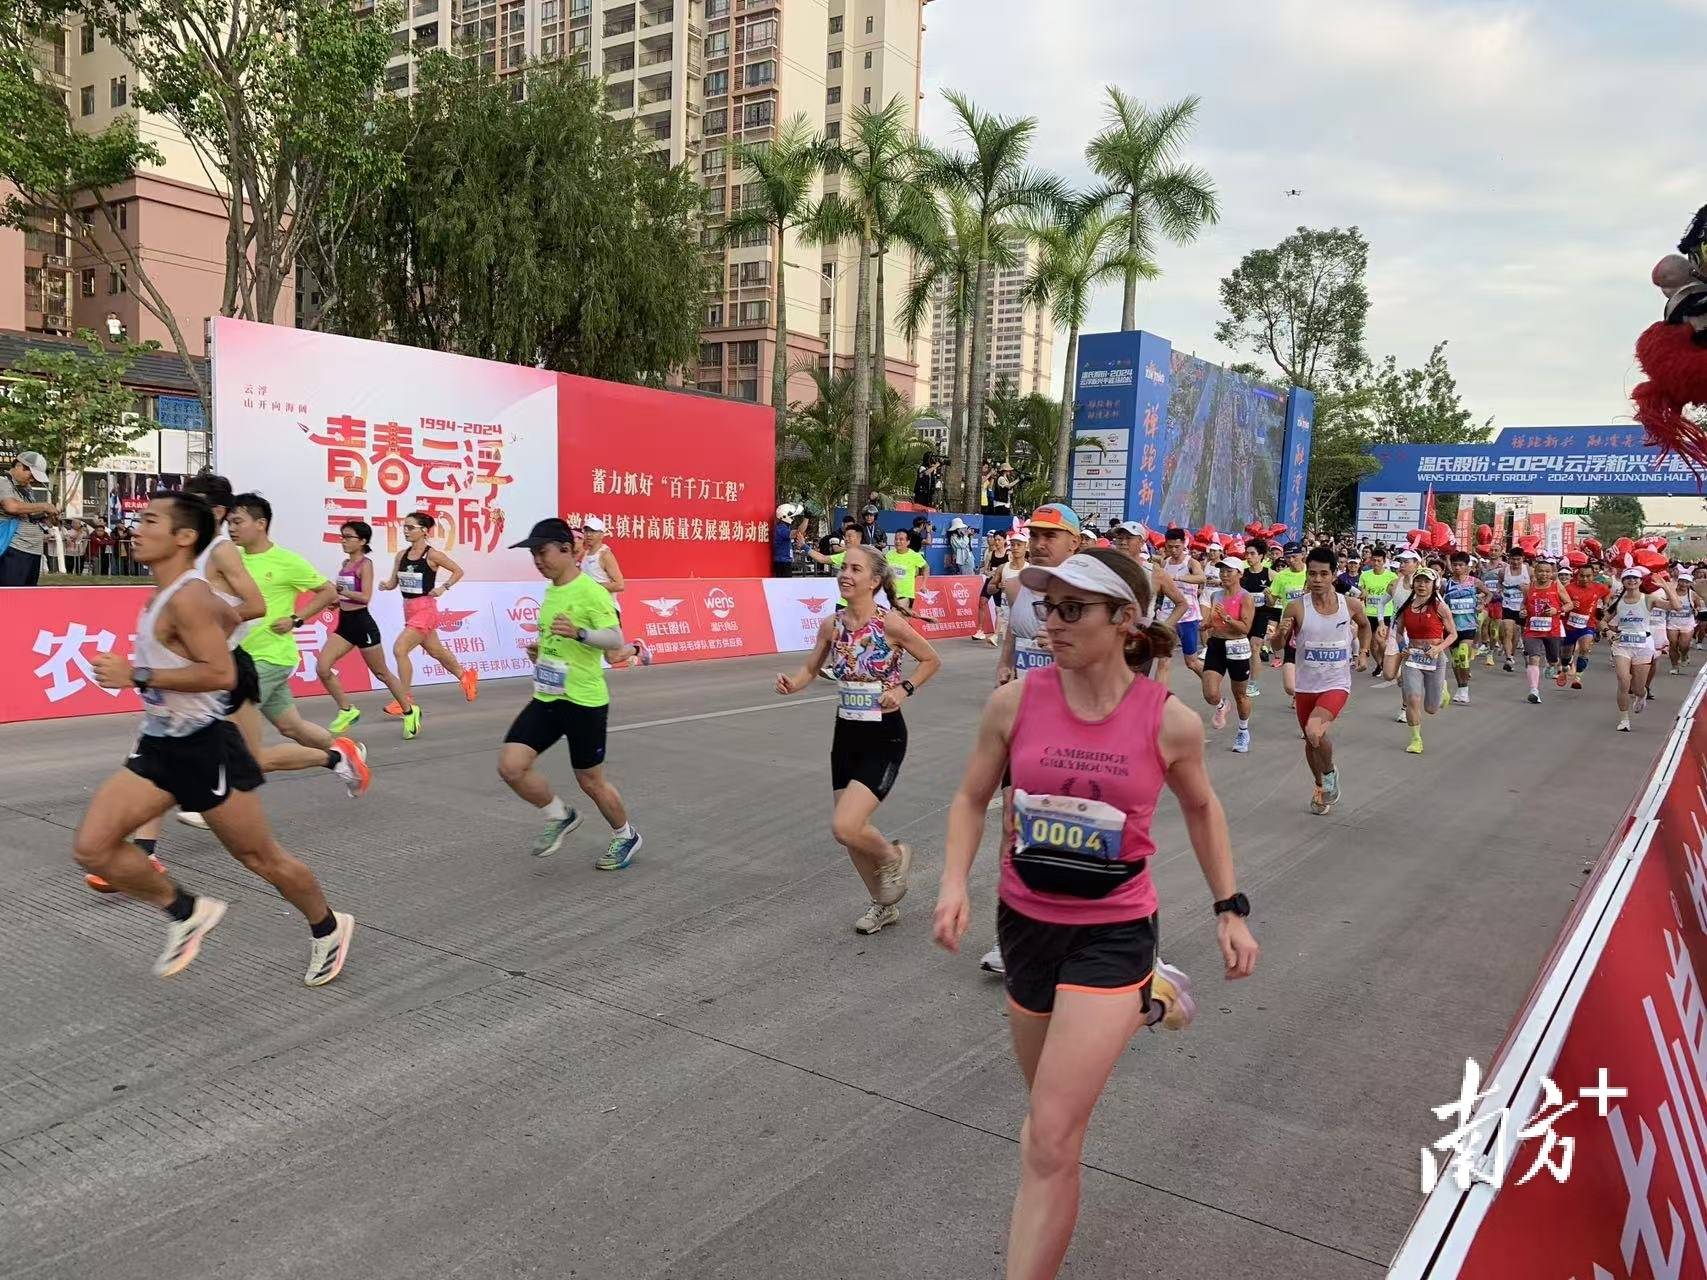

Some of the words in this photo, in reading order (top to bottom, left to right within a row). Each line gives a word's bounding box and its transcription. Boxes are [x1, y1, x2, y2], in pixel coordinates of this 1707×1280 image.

[244, 384, 268, 396] 云浮
[419, 417, 503, 436] 1994-2024
[308, 415, 514, 500] 青春云浮
[1418, 473, 1444, 482] WENS
[1446, 473, 1500, 482] FOODSTUFF
[1502, 473, 1537, 482] GROUP
[1548, 473, 1574, 482] 2024
[1576, 473, 1612, 482] YUNFU
[1614, 473, 1662, 482] XINXING
[1664, 473, 1692, 482] HALF
[704, 594, 735, 609] wens
[645, 621, 690, 637] 温氏股份
[1017, 653, 1026, 668] A
[1306, 651, 1315, 660] A
[1319, 650, 1341, 660] 1707
[843, 694, 873, 707] 0005
[1043, 746, 1129, 765] CAMBRIDGE
[1039, 757, 1129, 777] GREYHOUNDS
[1032, 819, 1102, 851] 0004
